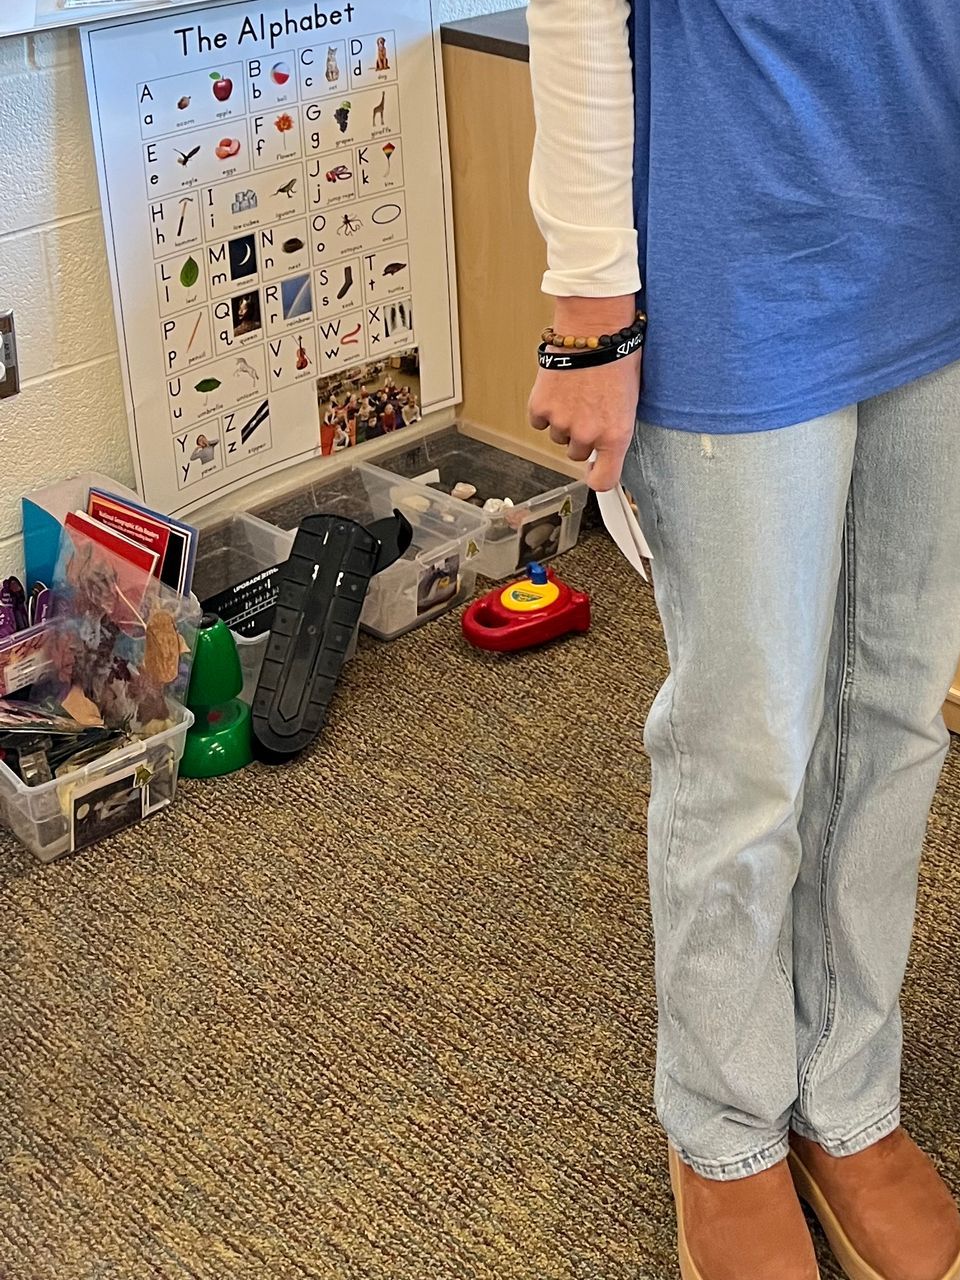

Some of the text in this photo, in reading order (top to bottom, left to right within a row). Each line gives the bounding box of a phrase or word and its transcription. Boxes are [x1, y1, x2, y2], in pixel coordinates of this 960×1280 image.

[174, 3, 355, 56] The Alphabet
[350, 39, 363, 56] D
[300, 48, 314, 66] C
[249, 60, 261, 78] B
[354, 59, 362, 76] d
[305, 77, 313, 87] c
[140, 84, 154, 103] A
[252, 83, 262, 99] b
[144, 114, 153, 125] a
[306, 104, 321, 121] G
[254, 116, 264, 134] F
[256, 139, 265, 156] f
[311, 132, 320, 149] g
[147, 144, 158, 162] E
[358, 147, 369, 165] K
[309, 160, 320, 177] J
[362, 169, 369, 185] k
[150, 174, 159, 185] e
[207, 188, 214, 206] I
[313, 184, 321, 203] j
[151, 203, 164, 223] H
[210, 213, 215, 228] i
[313, 215, 326, 231] O
[156, 227, 165, 244] h
[261, 229, 274, 248] N
[208, 244, 226, 264] M
[317, 242, 325, 252] o
[265, 258, 274, 268] n
[365, 254, 376, 271] T
[160, 264, 171, 281] L
[212, 272, 227, 286] m
[320, 269, 329, 286] S
[165, 285, 170, 302] l
[369, 279, 376, 291] t
[266, 285, 278, 304] R
[322, 296, 329, 306] s
[214, 302, 230, 319] Q
[270, 313, 278, 323] r
[368, 306, 381, 325] X
[163, 320, 176, 340] P
[219, 330, 233, 345] q
[320, 319, 341, 340] W
[371, 333, 380, 344] x
[269, 339, 282, 357] V
[325, 347, 340, 359] w
[168, 351, 177, 369] p
[273, 367, 282, 378] v
[169, 378, 181, 397] U
[173, 407, 182, 418] u
[224, 413, 236, 432] Z
[177, 434, 188, 453] Y
[228, 441, 237, 454] z
[182, 463, 190, 482] y
